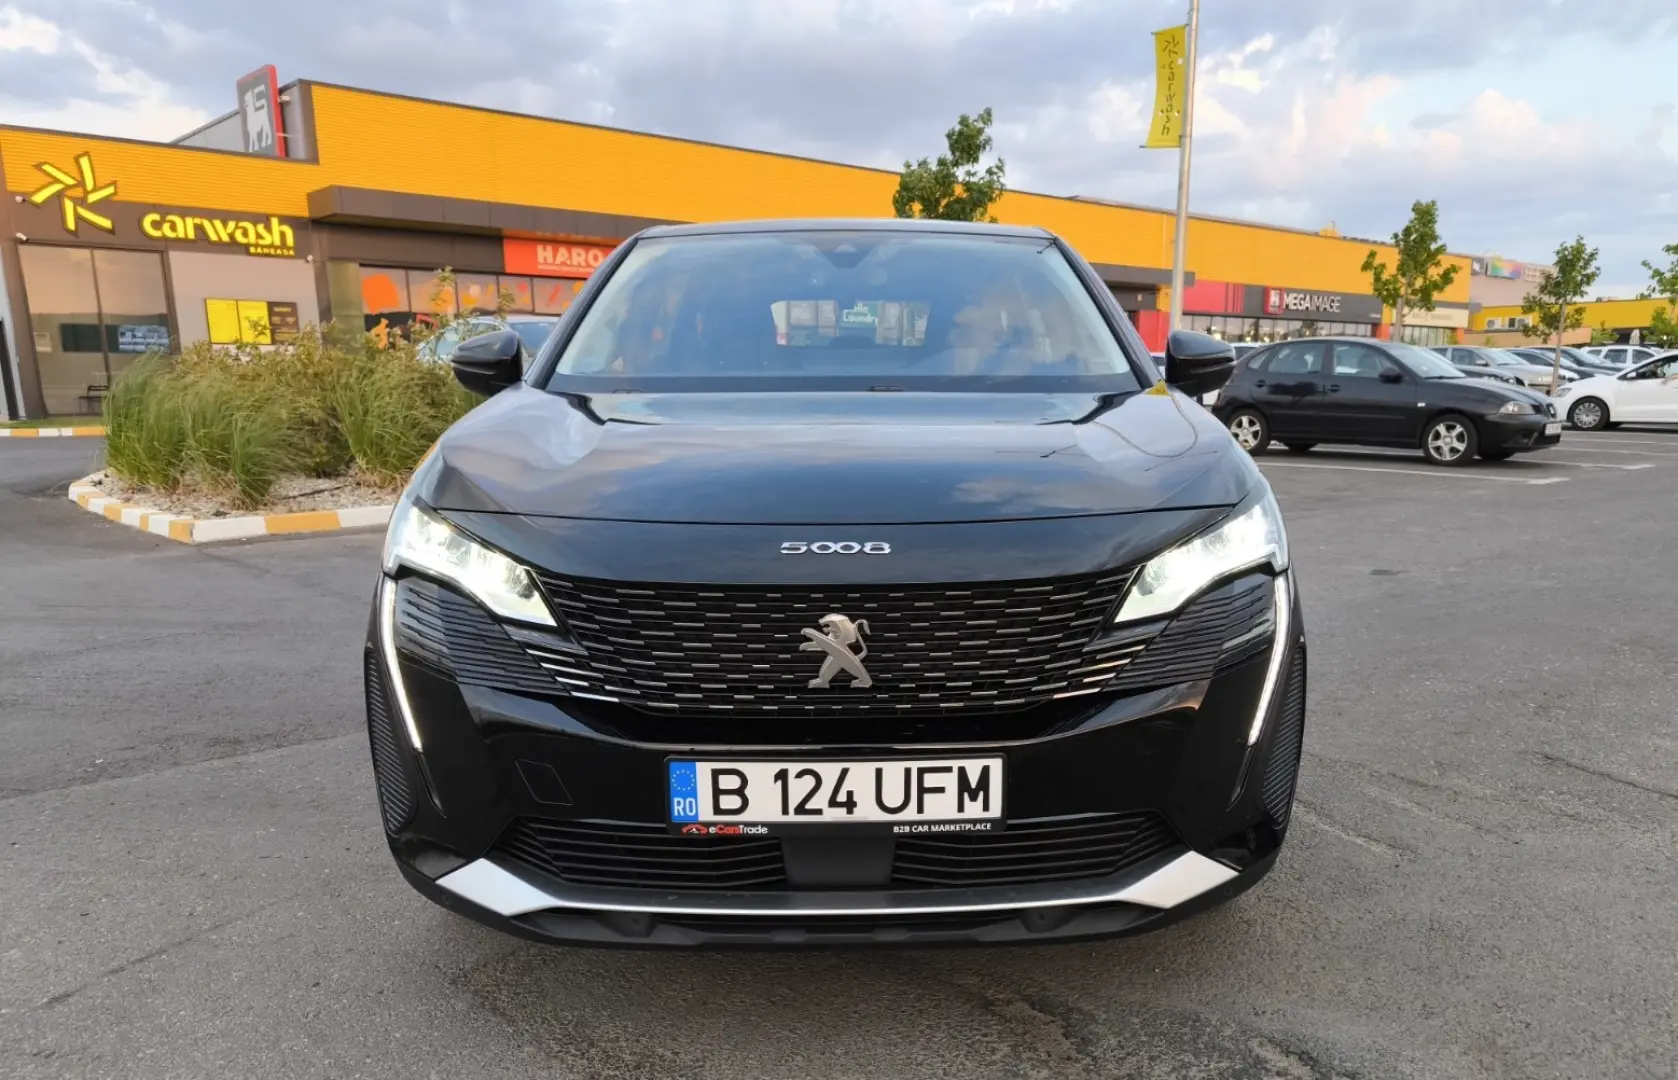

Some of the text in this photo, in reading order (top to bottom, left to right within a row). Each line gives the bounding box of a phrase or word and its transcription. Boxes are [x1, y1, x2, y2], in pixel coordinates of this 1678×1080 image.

[141, 212, 295, 247] carwash
[780, 541, 891, 554] 5008
[710, 765, 991, 816] B 124 UFM
[674, 797, 696, 816] RO
[892, 822, 993, 833] B2B CAR MARKETPLACE
